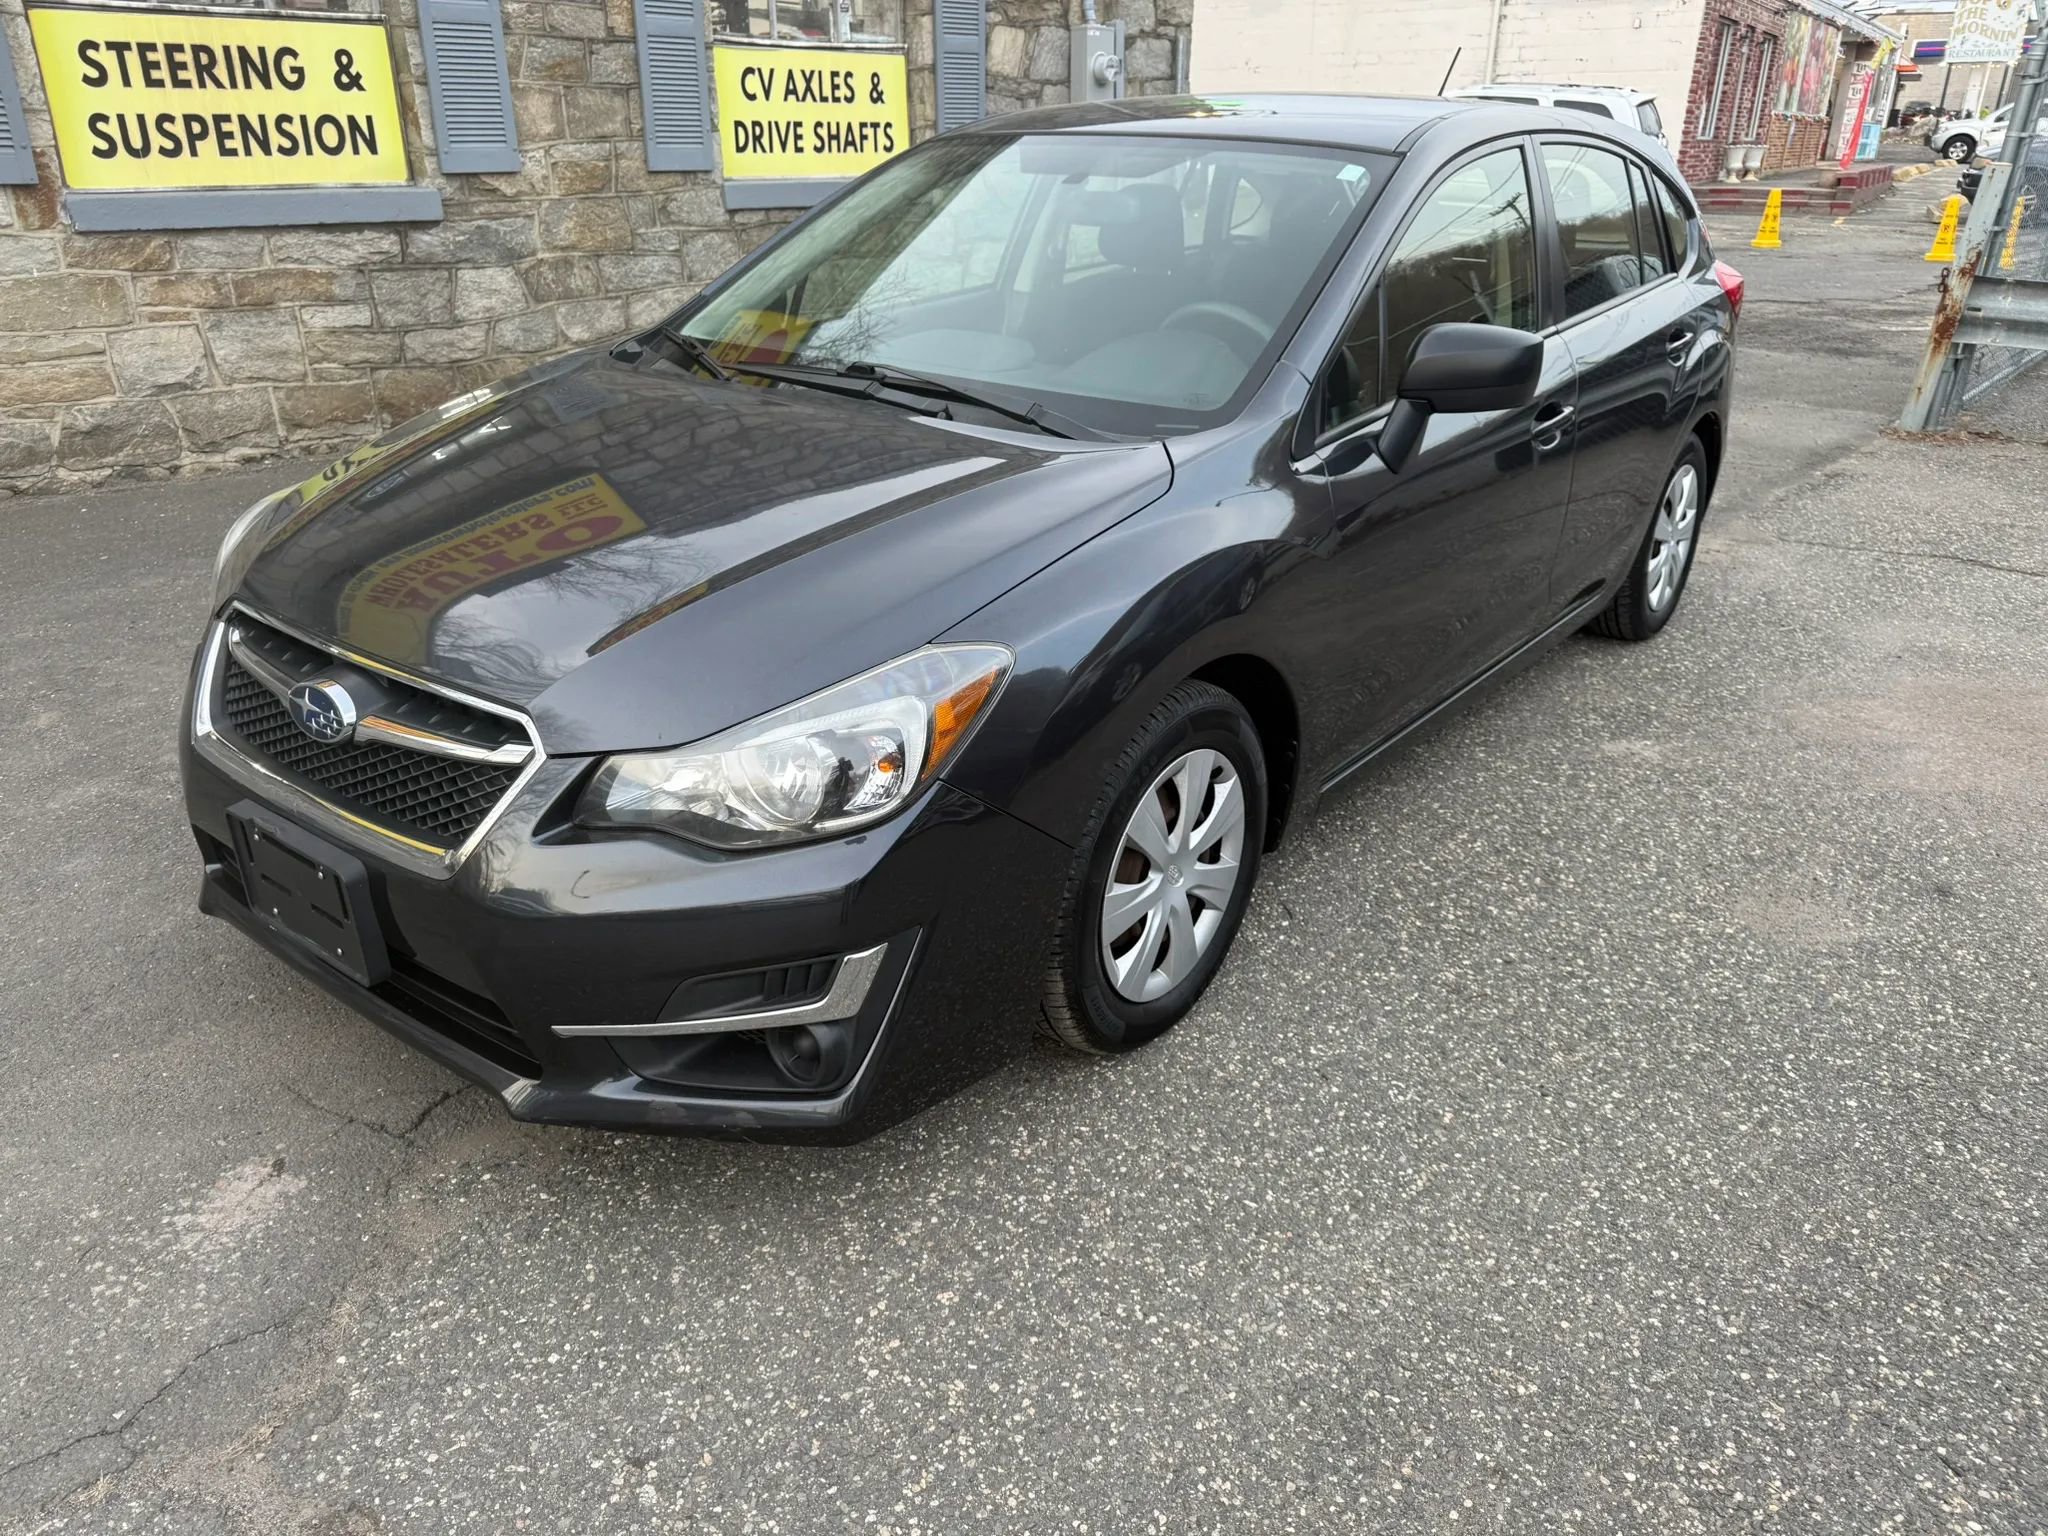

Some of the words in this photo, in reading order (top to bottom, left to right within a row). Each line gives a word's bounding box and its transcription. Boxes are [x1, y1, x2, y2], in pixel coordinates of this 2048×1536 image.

[1959, 7, 1987, 26] THE
[78, 39, 305, 91] STEERING
[333, 48, 366, 92] &
[1948, 49, 2016, 58] RESTAURANT
[740, 66, 775, 102] CV
[783, 69, 856, 104] AXLES
[869, 72, 886, 104] &
[87, 112, 379, 159] SUSPENSION
[733, 120, 804, 153] DRIVE
[813, 121, 895, 154] SHAFTS
